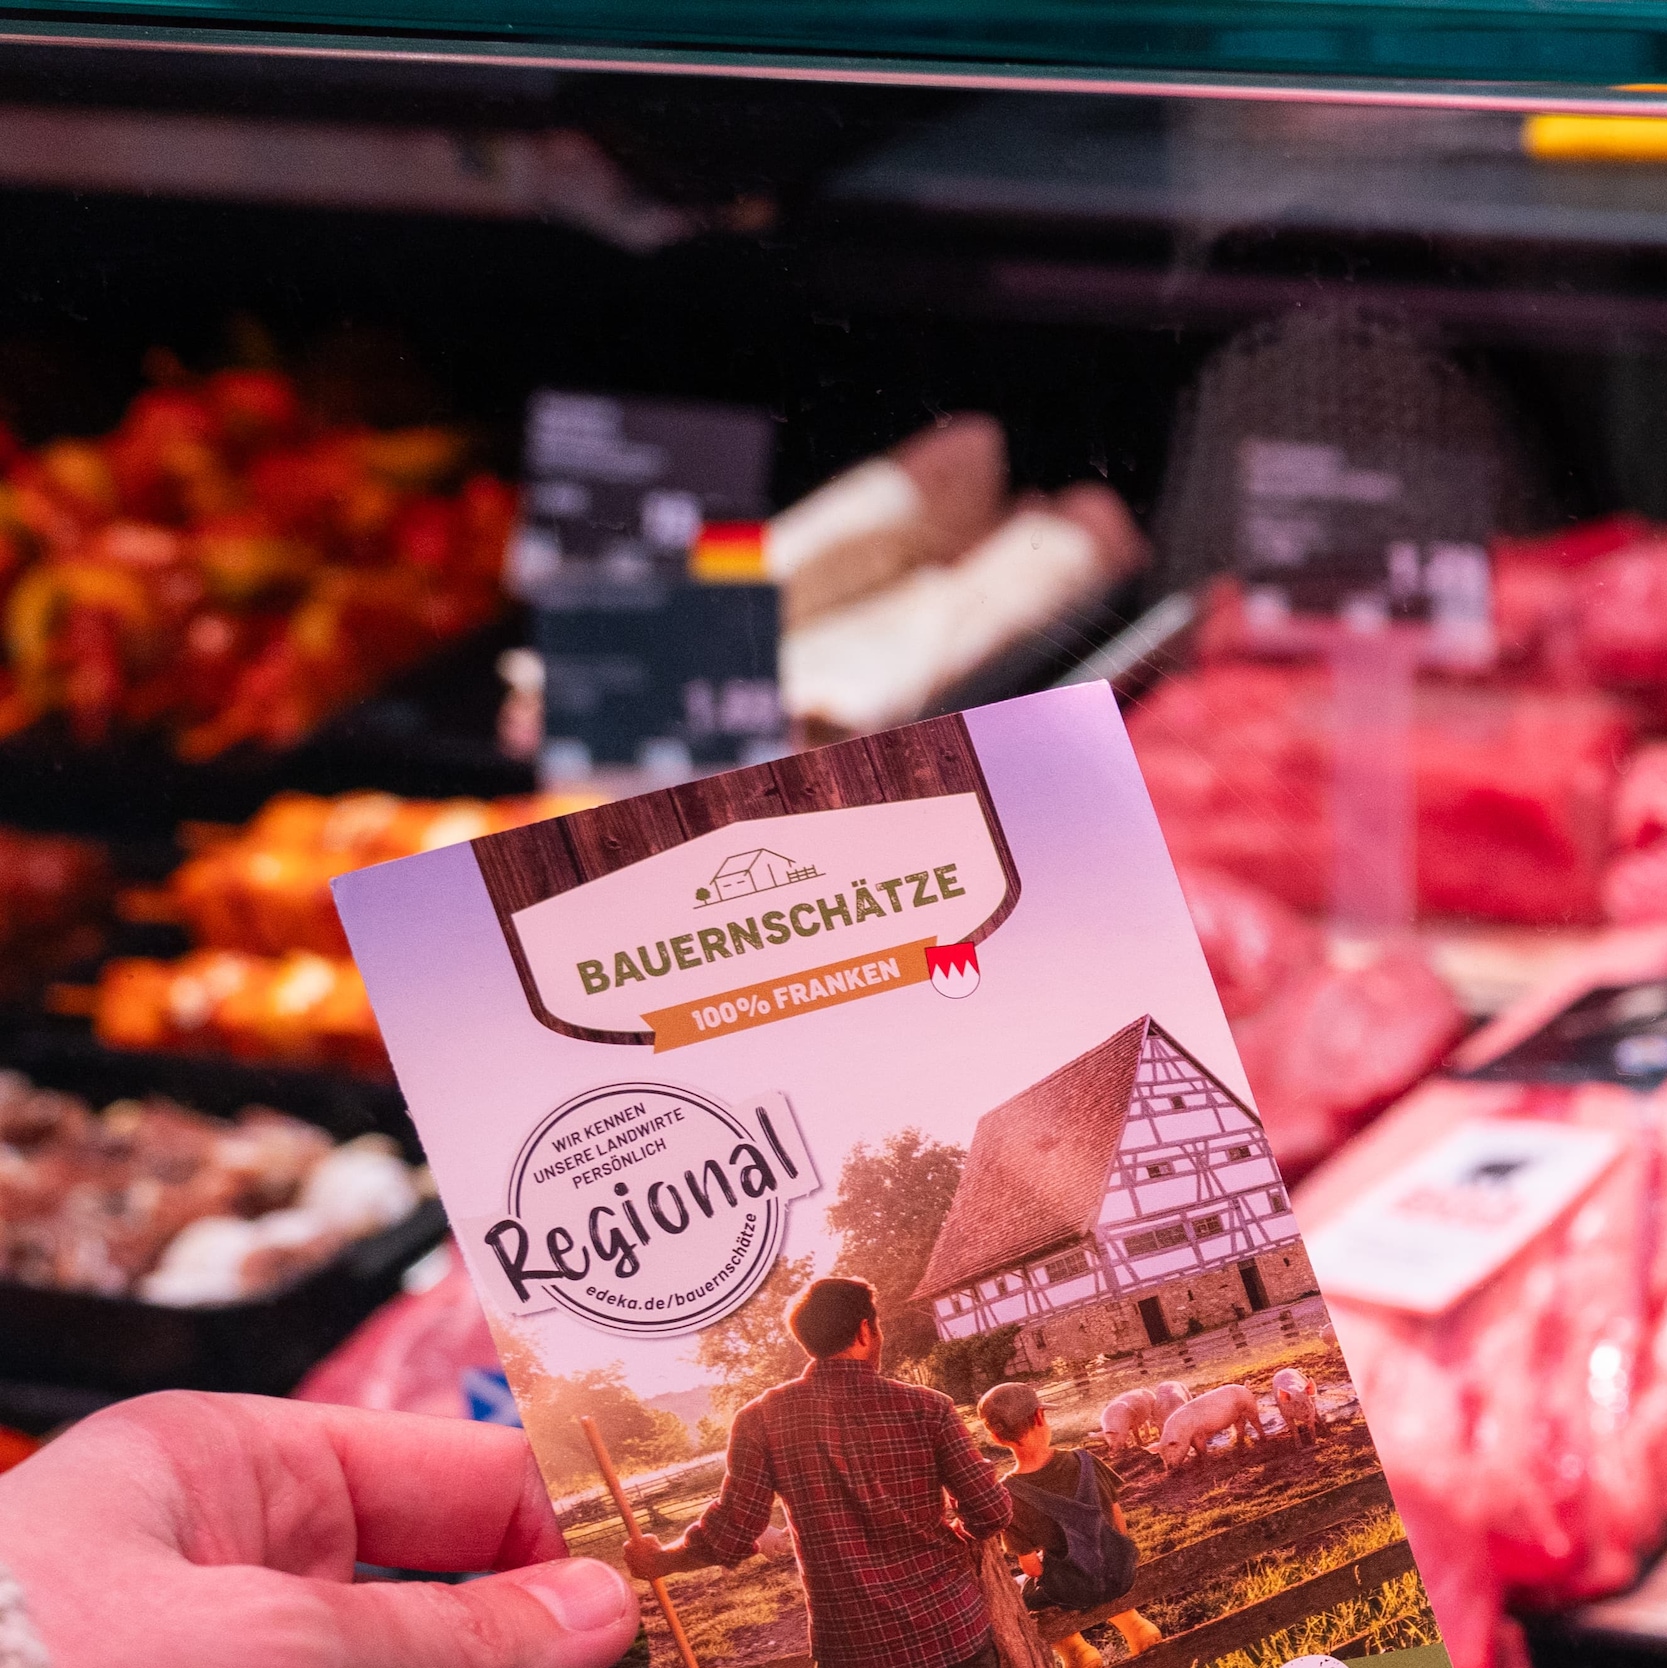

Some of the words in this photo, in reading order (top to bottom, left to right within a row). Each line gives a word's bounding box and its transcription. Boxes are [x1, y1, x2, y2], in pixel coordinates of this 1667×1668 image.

[576, 863, 966, 995] BAUERNSCHÄTZE
[692, 993, 771, 1032] 100%
[773, 957, 901, 1010] FRANKEN
[533, 1150, 596, 1184] UNSERE
[595, 1107, 686, 1158] LANDWIRTE
[551, 1131, 583, 1153] WIR
[583, 1102, 647, 1140] KENNEN
[572, 1137, 667, 1189] PERSÖNLICH
[484, 1106, 799, 1303] Regional
[585, 1213, 758, 1311] edeka.de/bauernschätze
